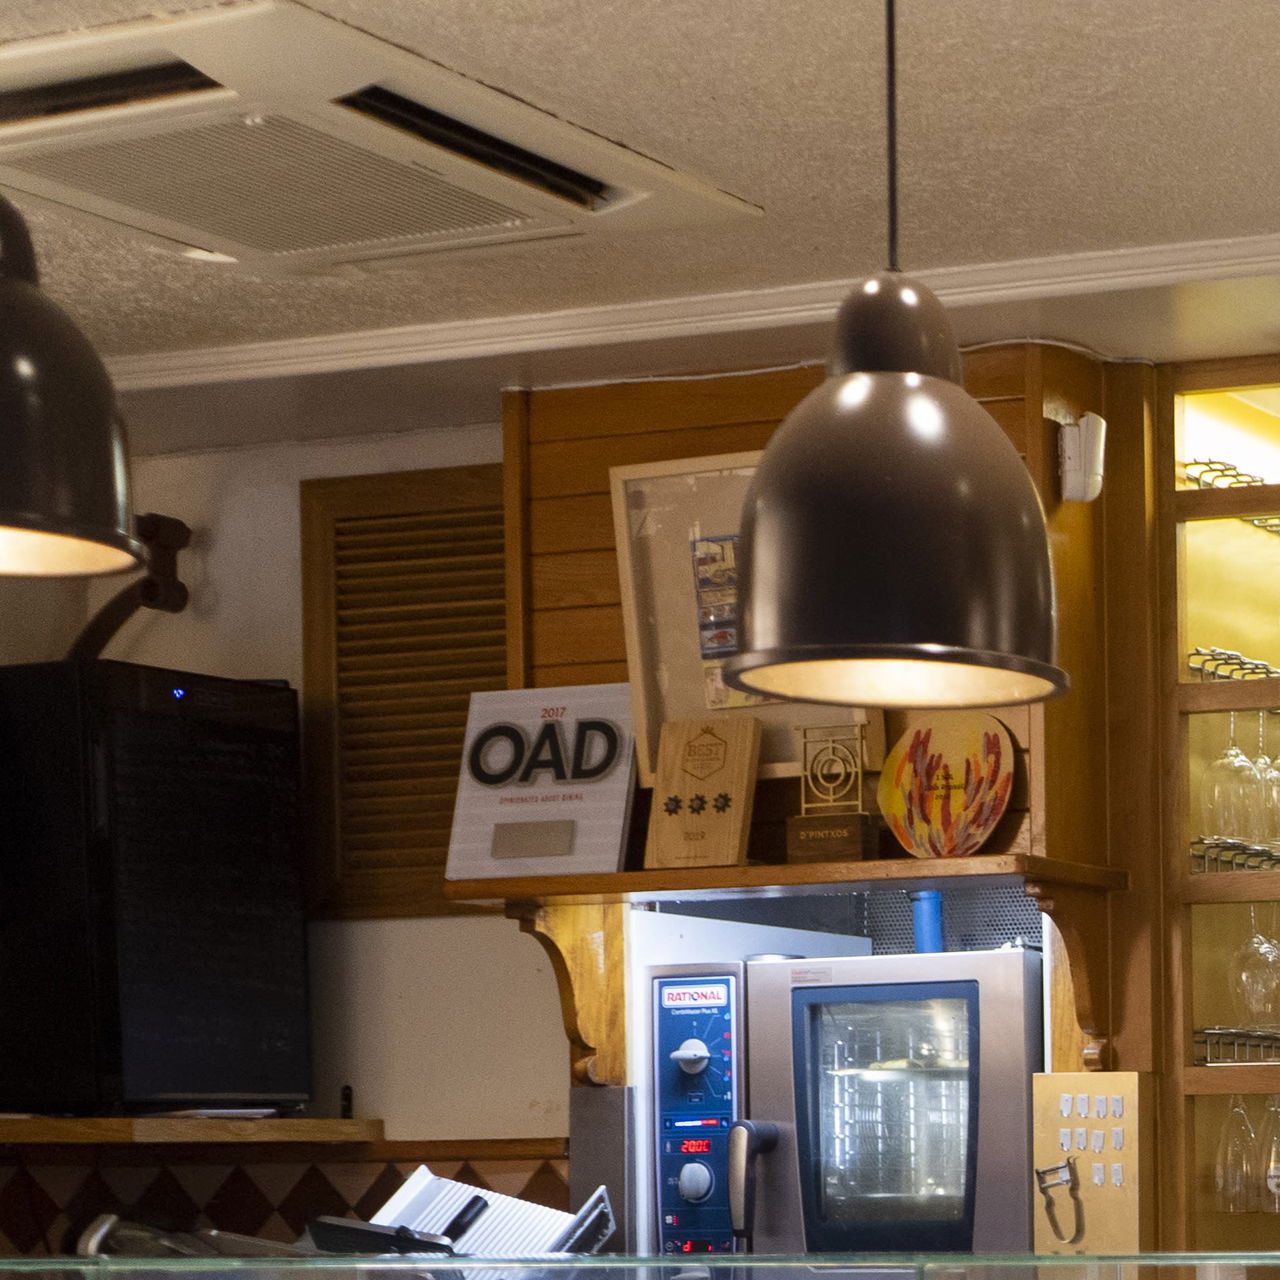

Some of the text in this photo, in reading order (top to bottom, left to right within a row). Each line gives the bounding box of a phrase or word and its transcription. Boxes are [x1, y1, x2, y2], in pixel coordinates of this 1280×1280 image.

[540, 707, 567, 719] 2017
[469, 720, 620, 786] OAD
[667, 991, 722, 1002] RATIONAL
